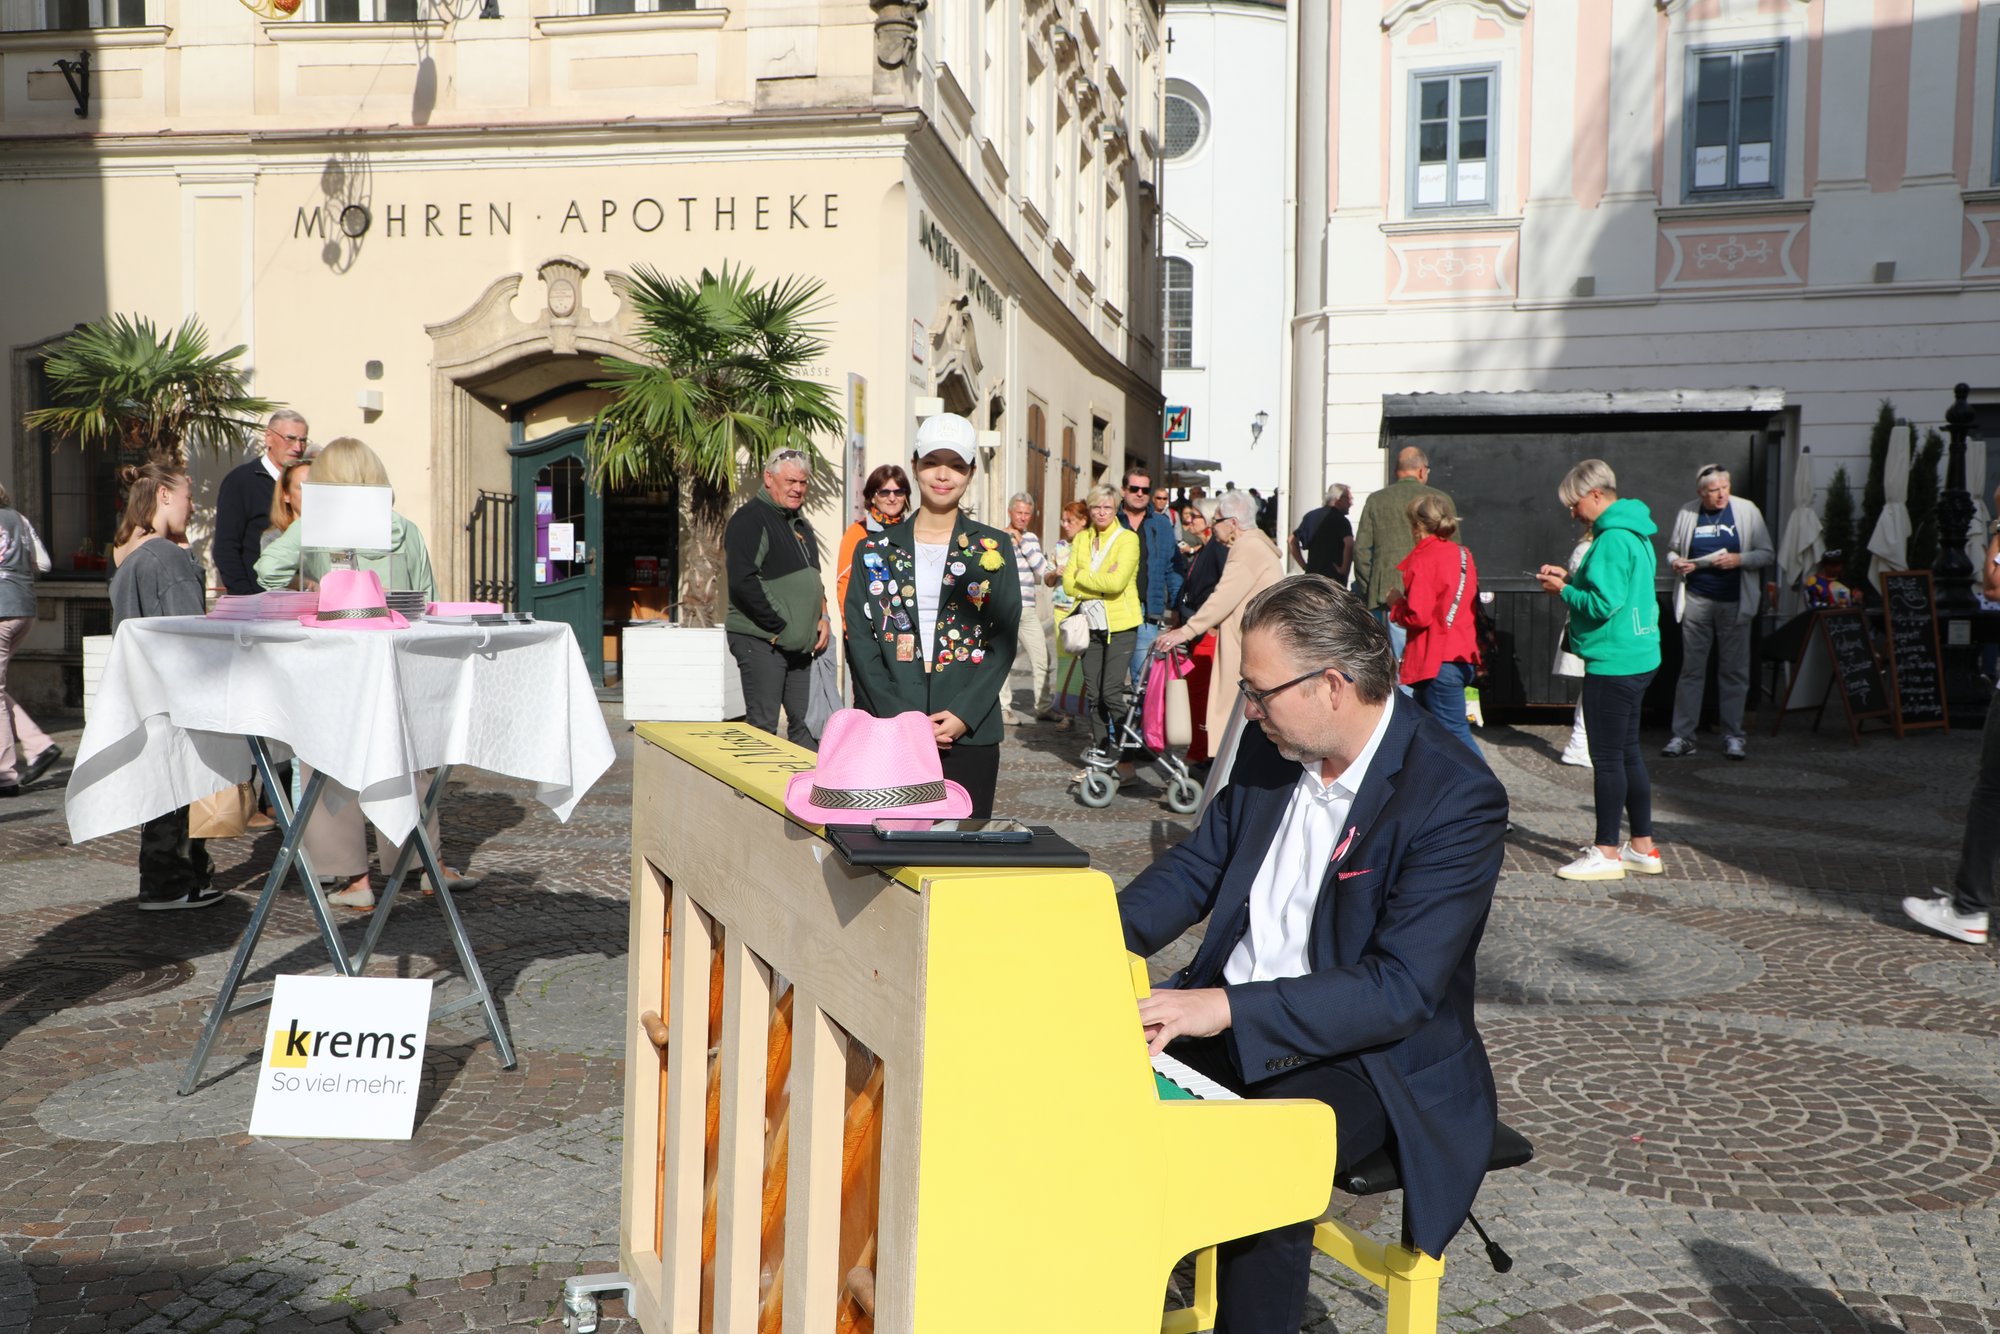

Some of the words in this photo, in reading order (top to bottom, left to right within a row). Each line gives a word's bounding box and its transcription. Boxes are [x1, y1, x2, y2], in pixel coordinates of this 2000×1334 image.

[294, 201, 512, 239] MOHREN
[560, 194, 839, 233] APOTHEKE
[286, 1019, 417, 1060] krems
[271, 1072, 300, 1092] So
[306, 1073, 341, 1093] viel
[346, 1075, 407, 1095] mehr.
